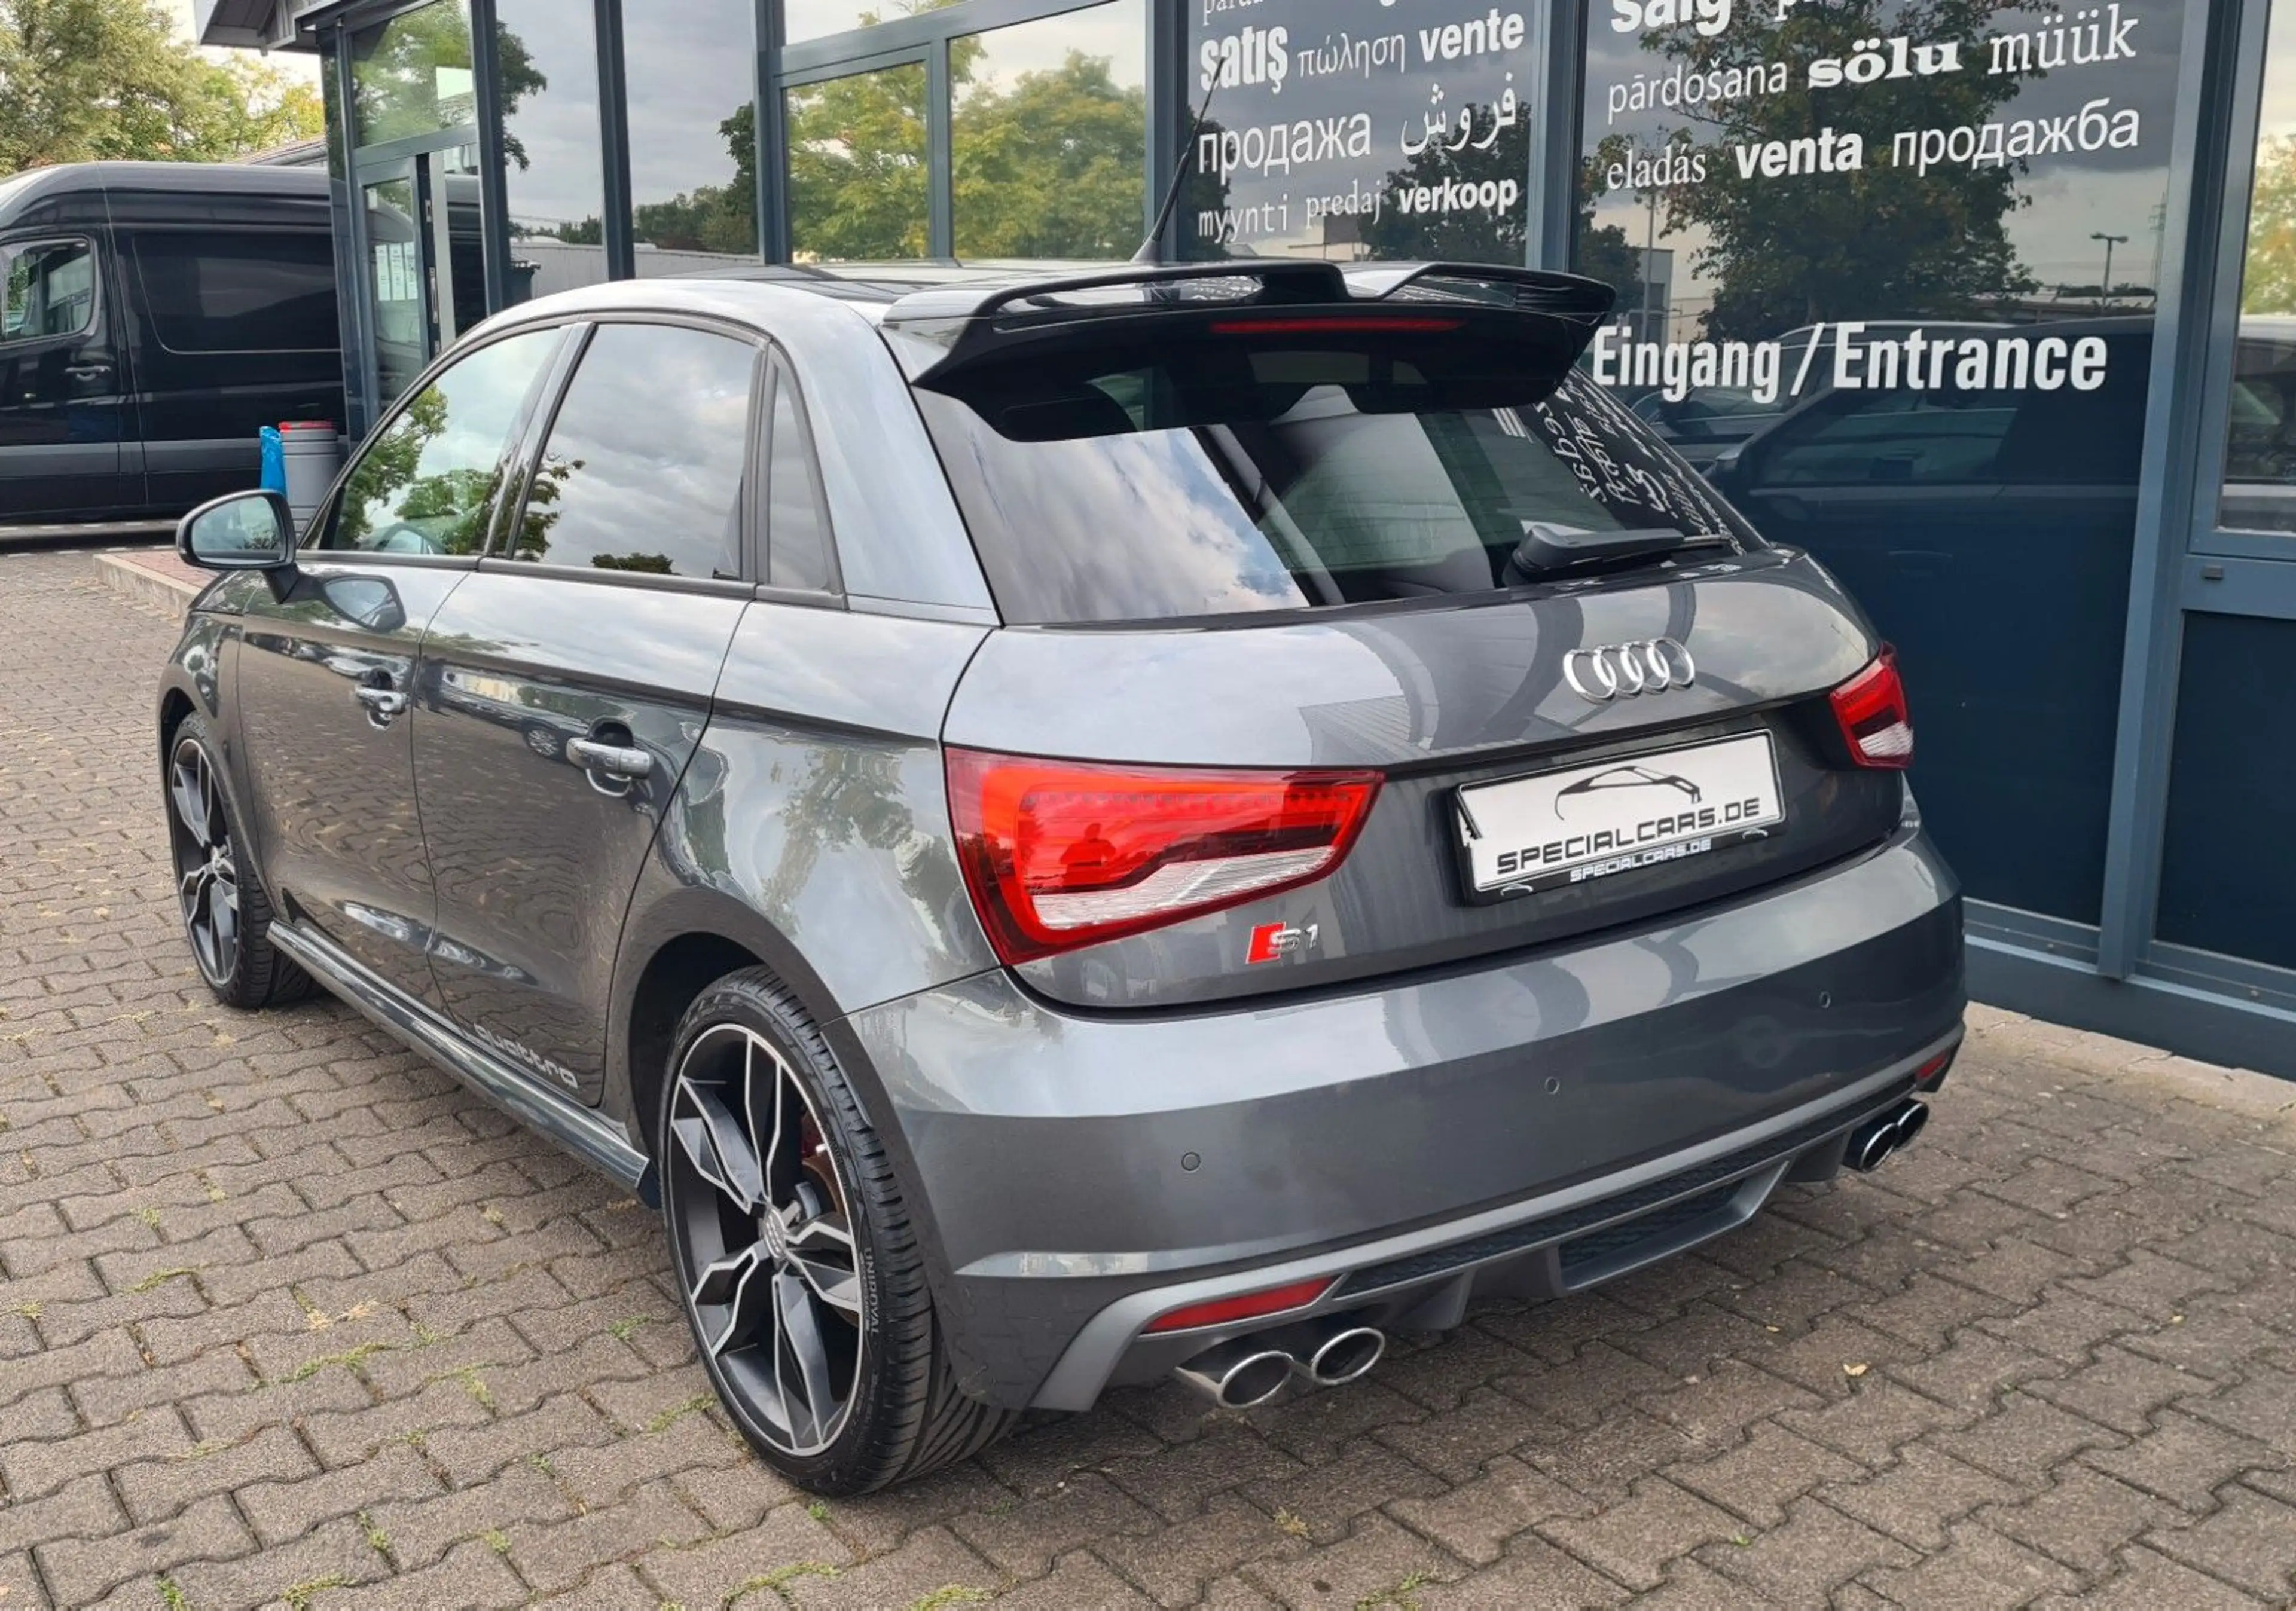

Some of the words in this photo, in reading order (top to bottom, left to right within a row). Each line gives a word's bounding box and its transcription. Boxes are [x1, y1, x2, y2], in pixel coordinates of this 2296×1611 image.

[1297, 32, 1405, 79] πώληση
[1419, 8, 1524, 62] vente
[1608, 61, 1787, 125] pārdošana
[1808, 37, 1963, 88] sölu
[1987, 3, 2138, 75] müük
[1199, 112, 1372, 185] продажа
[1400, 71, 1516, 155] فروش
[1892, 97, 2139, 177] продажба
[1607, 143, 1706, 191] eladás
[1735, 127, 1863, 179] venta
[1199, 194, 1289, 244] myynti
[1305, 179, 1381, 233] predaj
[1399, 177, 1517, 216] verkoop
[1593, 326, 1781, 403] Eingang
[1497, 797, 1760, 875] SPECIALCARS.DE
[1570, 837, 1713, 882] SPECIALCARS.DE
